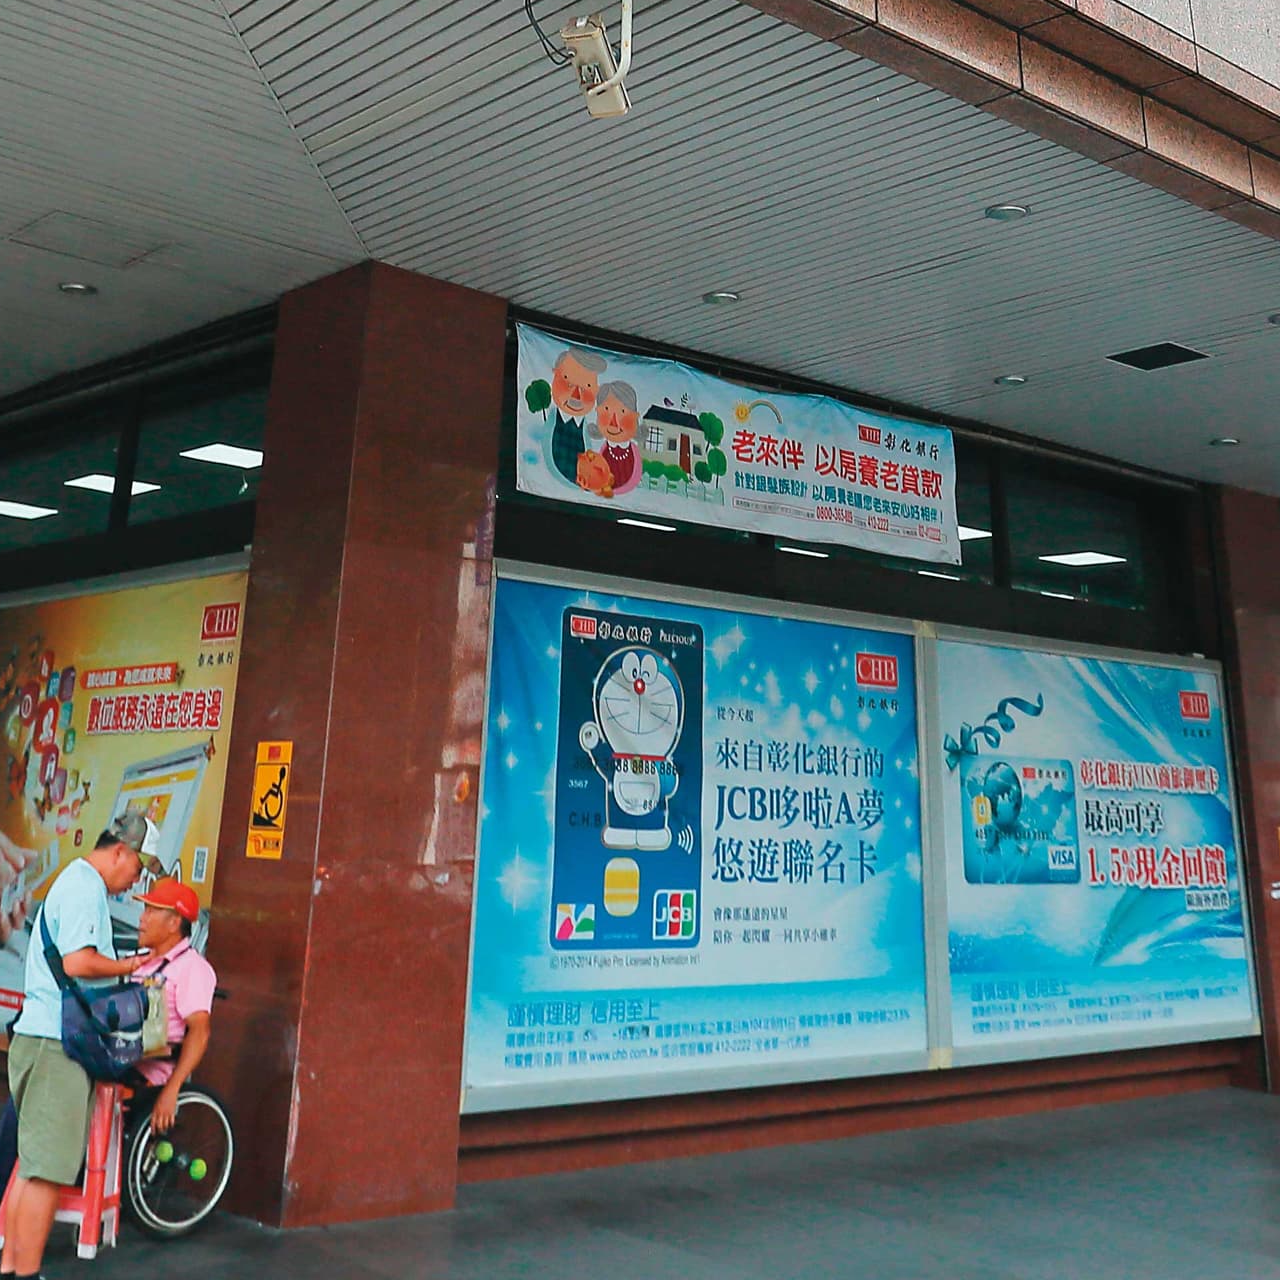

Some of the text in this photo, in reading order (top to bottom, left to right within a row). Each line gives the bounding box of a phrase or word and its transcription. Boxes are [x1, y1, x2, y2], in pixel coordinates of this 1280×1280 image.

[884, 432, 940, 462] 彰化銀行
[731, 429, 943, 500] 老來伴 以房養老貸款
[204, 607, 238, 635] CHB
[572, 616, 596, 635] CHB
[599, 621, 653, 645] 彰化銀行
[857, 655, 897, 683] CHB
[87, 690, 223, 733] 數位服務永遠在您身邊
[1181, 694, 1210, 718] CHB
[715, 737, 884, 778] 來自彰化銀行的
[715, 784, 885, 831] JCB哆啦A夢
[1084, 799, 1163, 834] 最高可享
[712, 836, 879, 884] 悠遊聯名卡
[1051, 849, 1075, 864] VISA
[655, 905, 694, 923] JCB
